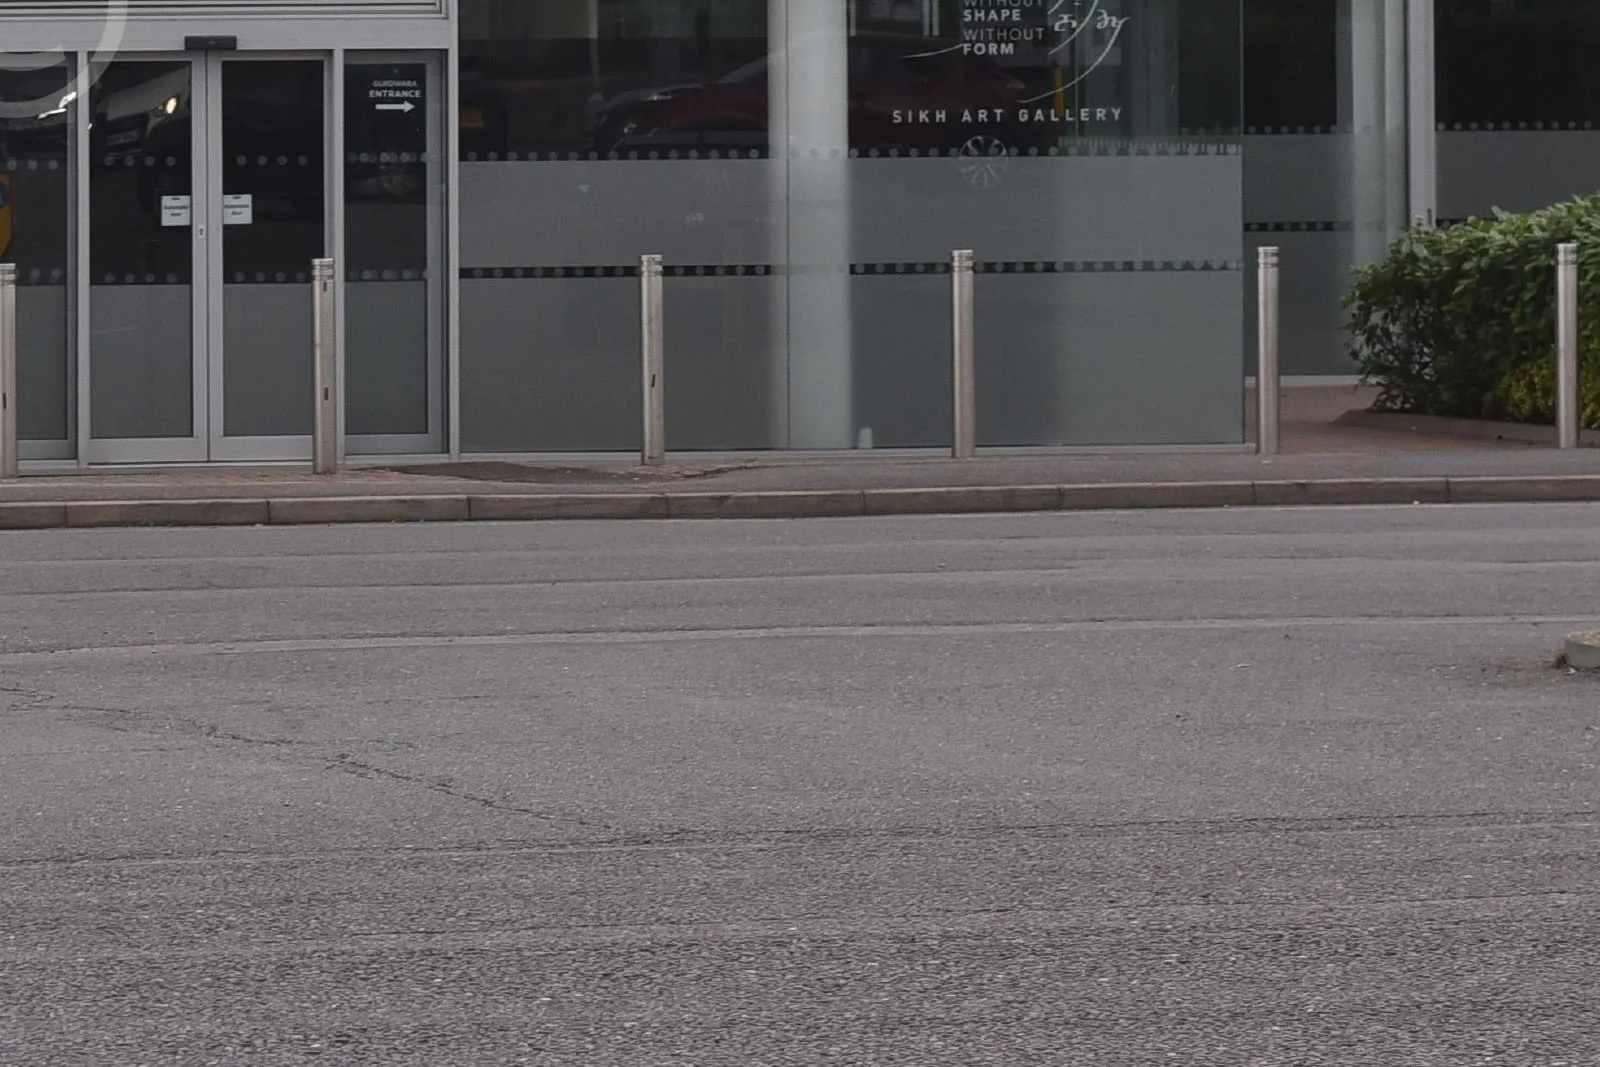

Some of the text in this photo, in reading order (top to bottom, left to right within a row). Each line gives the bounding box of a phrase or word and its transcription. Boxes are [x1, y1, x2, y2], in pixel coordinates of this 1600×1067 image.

[962, 8, 1021, 22] SHAPE
[962, 27, 1044, 41] WITHOUT
[962, 42, 1014, 55] FORM
[368, 89, 421, 98] ENTRANCE
[892, 107, 1122, 123] SIKH ART GALLERY
